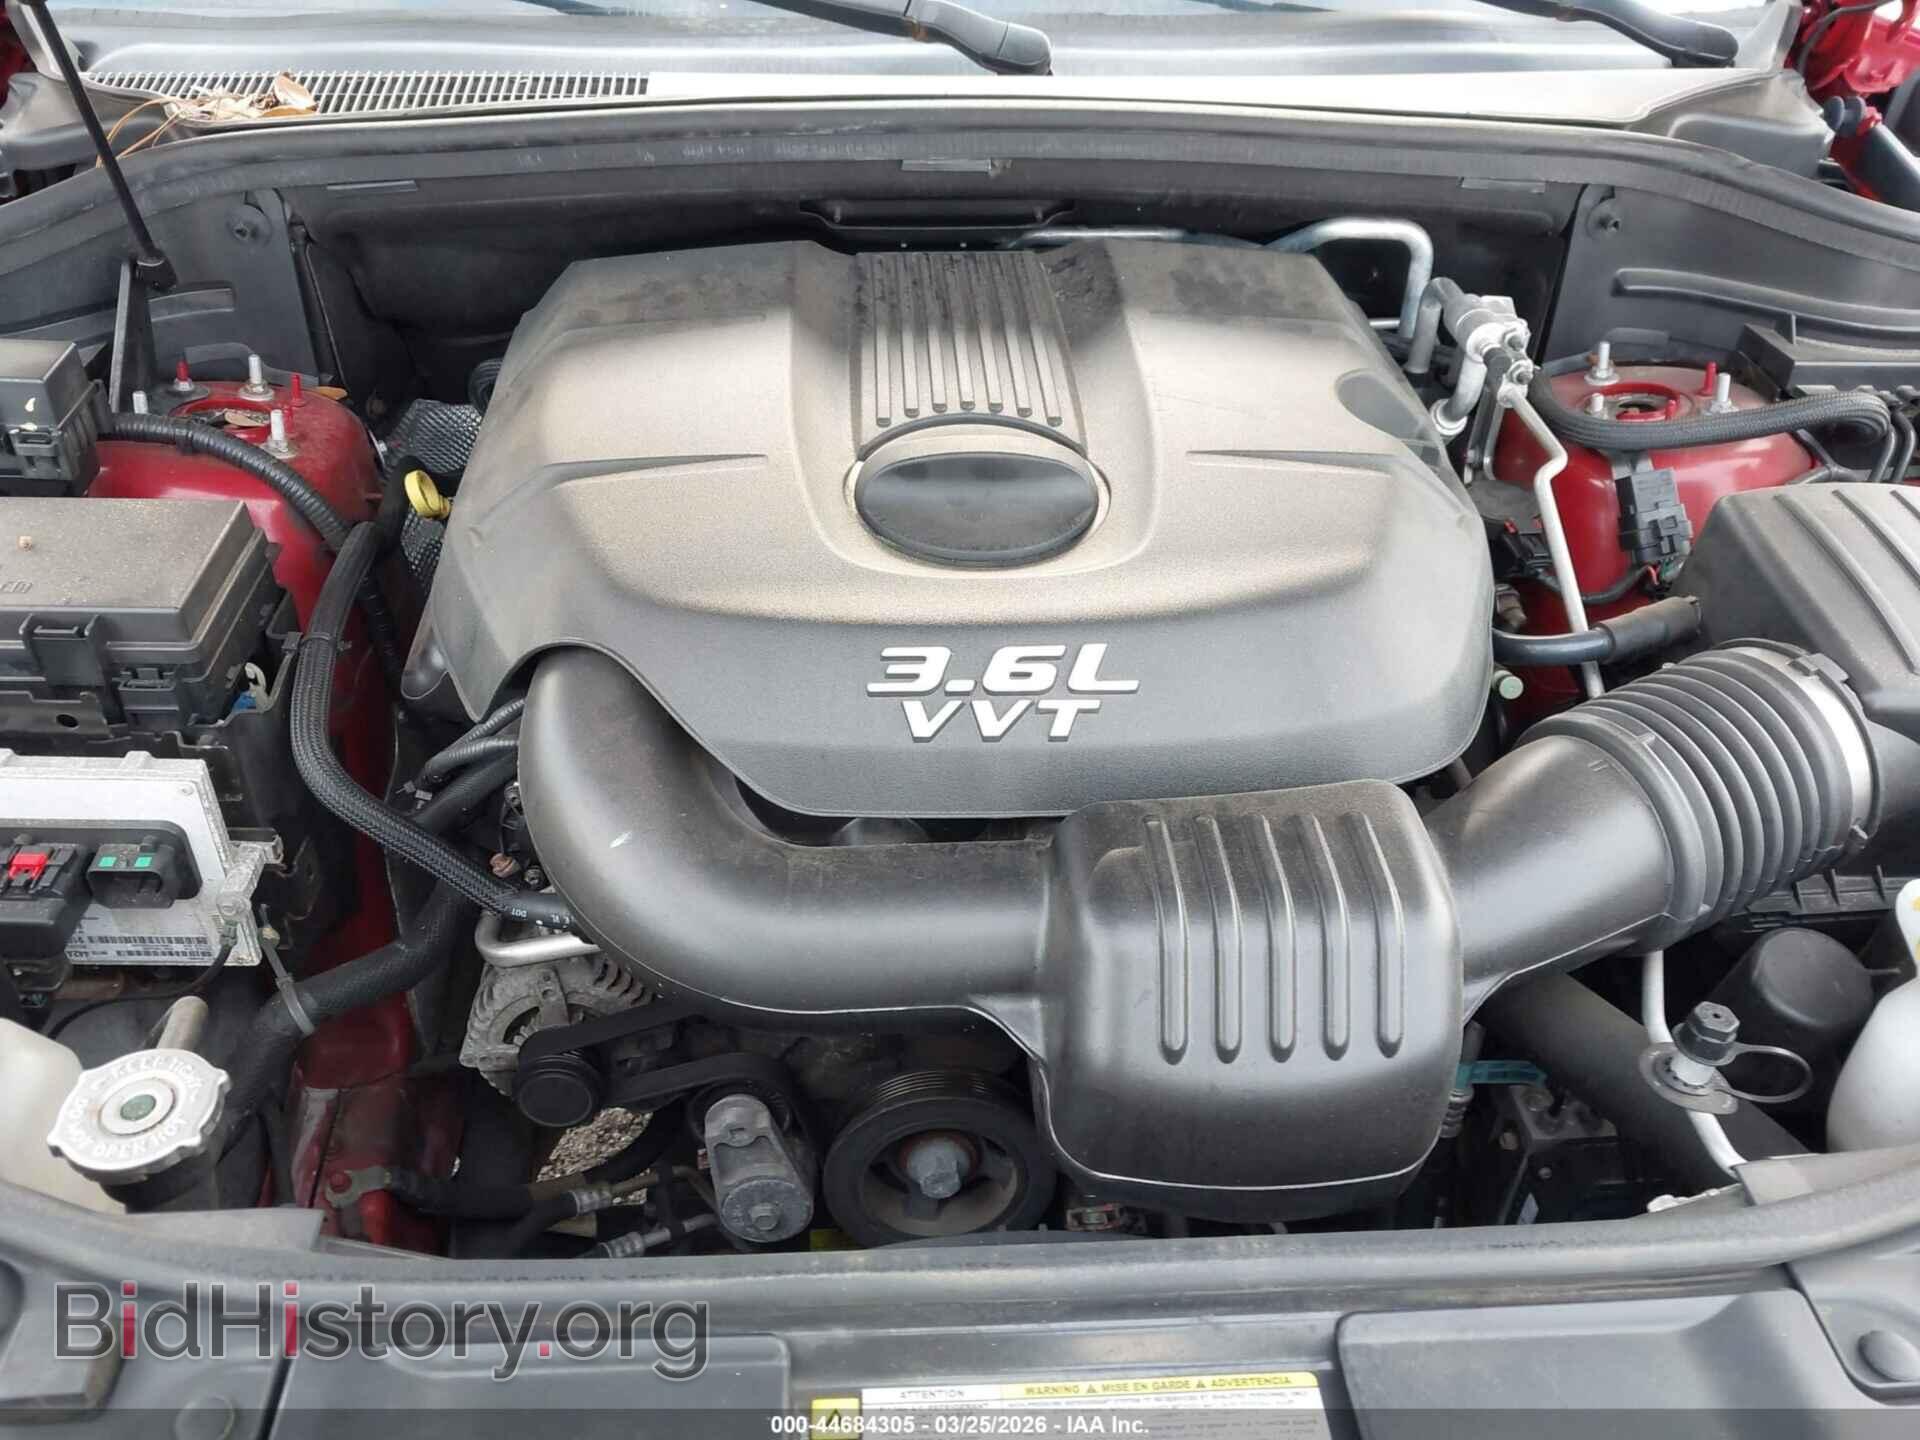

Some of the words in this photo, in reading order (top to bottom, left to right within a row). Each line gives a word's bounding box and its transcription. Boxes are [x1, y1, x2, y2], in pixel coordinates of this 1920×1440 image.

[866, 643, 1140, 697] 3.6L
[901, 699, 1101, 743] VVT
[92, 1139, 148, 1159] OPEN
[900, 1389, 965, 1399] ATTENTION
[1025, 1384, 1081, 1395] WARNING
[1101, 1382, 1130, 1392] MISE
[1132, 1381, 1148, 1391] EN
[1152, 1380, 1191, 1391] GARDE
[1211, 1375, 1292, 1388] ADVERTENCIA
